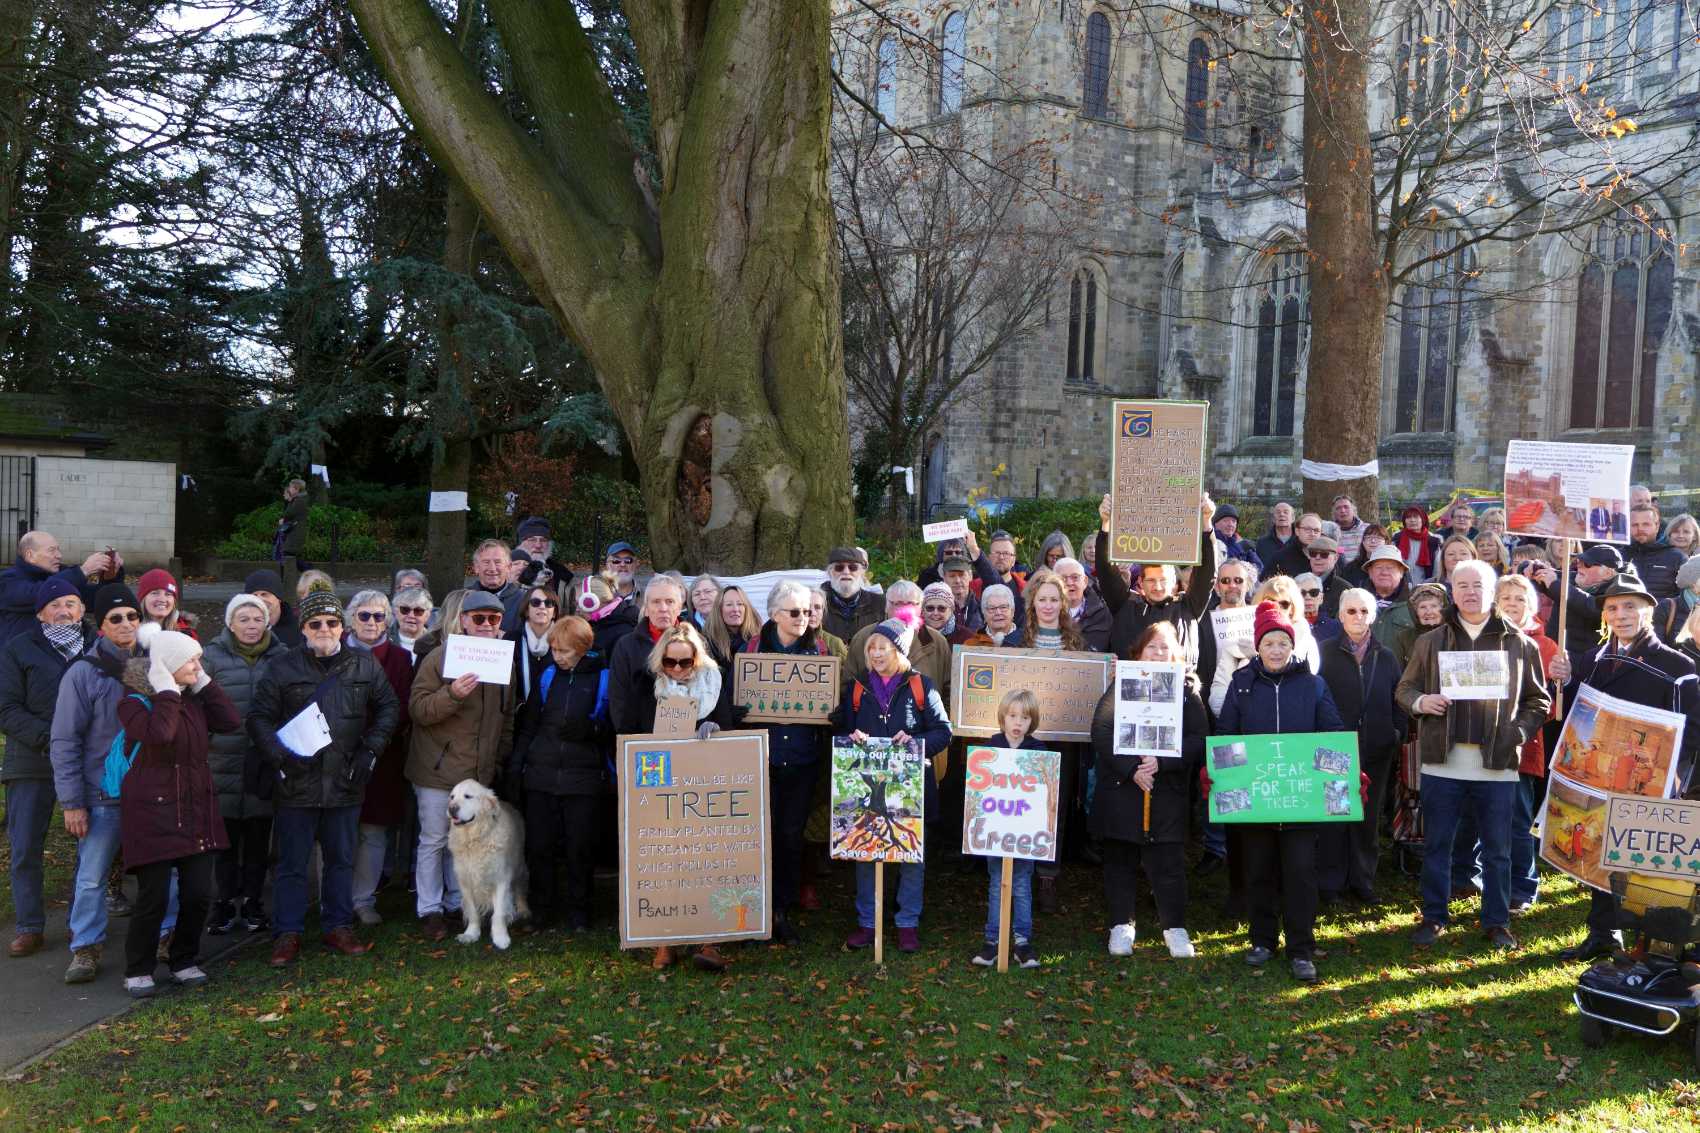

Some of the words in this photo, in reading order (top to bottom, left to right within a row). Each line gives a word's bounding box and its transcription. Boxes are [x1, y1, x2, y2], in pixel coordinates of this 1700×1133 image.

[1117, 535, 1163, 553] GOOD
[1216, 614, 1243, 625] HANDS
[743, 661, 831, 684] PLEASE
[773, 689, 791, 699] THE
[797, 690, 833, 701] TREES
[839, 749, 866, 760] Save
[869, 751, 887, 760] our
[891, 750, 919, 761] trees
[1270, 741, 1285, 759] I
[966, 749, 1038, 793] Save
[1255, 761, 1306, 780] SPEAK
[683, 776, 708, 786] WILL
[713, 775, 728, 785] BE
[1251, 780, 1280, 797] FOR
[1286, 778, 1312, 793] THE
[640, 794, 649, 806] A
[656, 790, 750, 819] TREE
[982, 797, 1032, 816] our
[1263, 795, 1309, 809] TREES
[1618, 802, 1692, 825] SPARE
[970, 817, 1055, 858] trees
[840, 849, 868, 858] Save
[871, 850, 890, 860] our
[893, 850, 918, 860] land
[683, 904, 699, 915] 1:3
